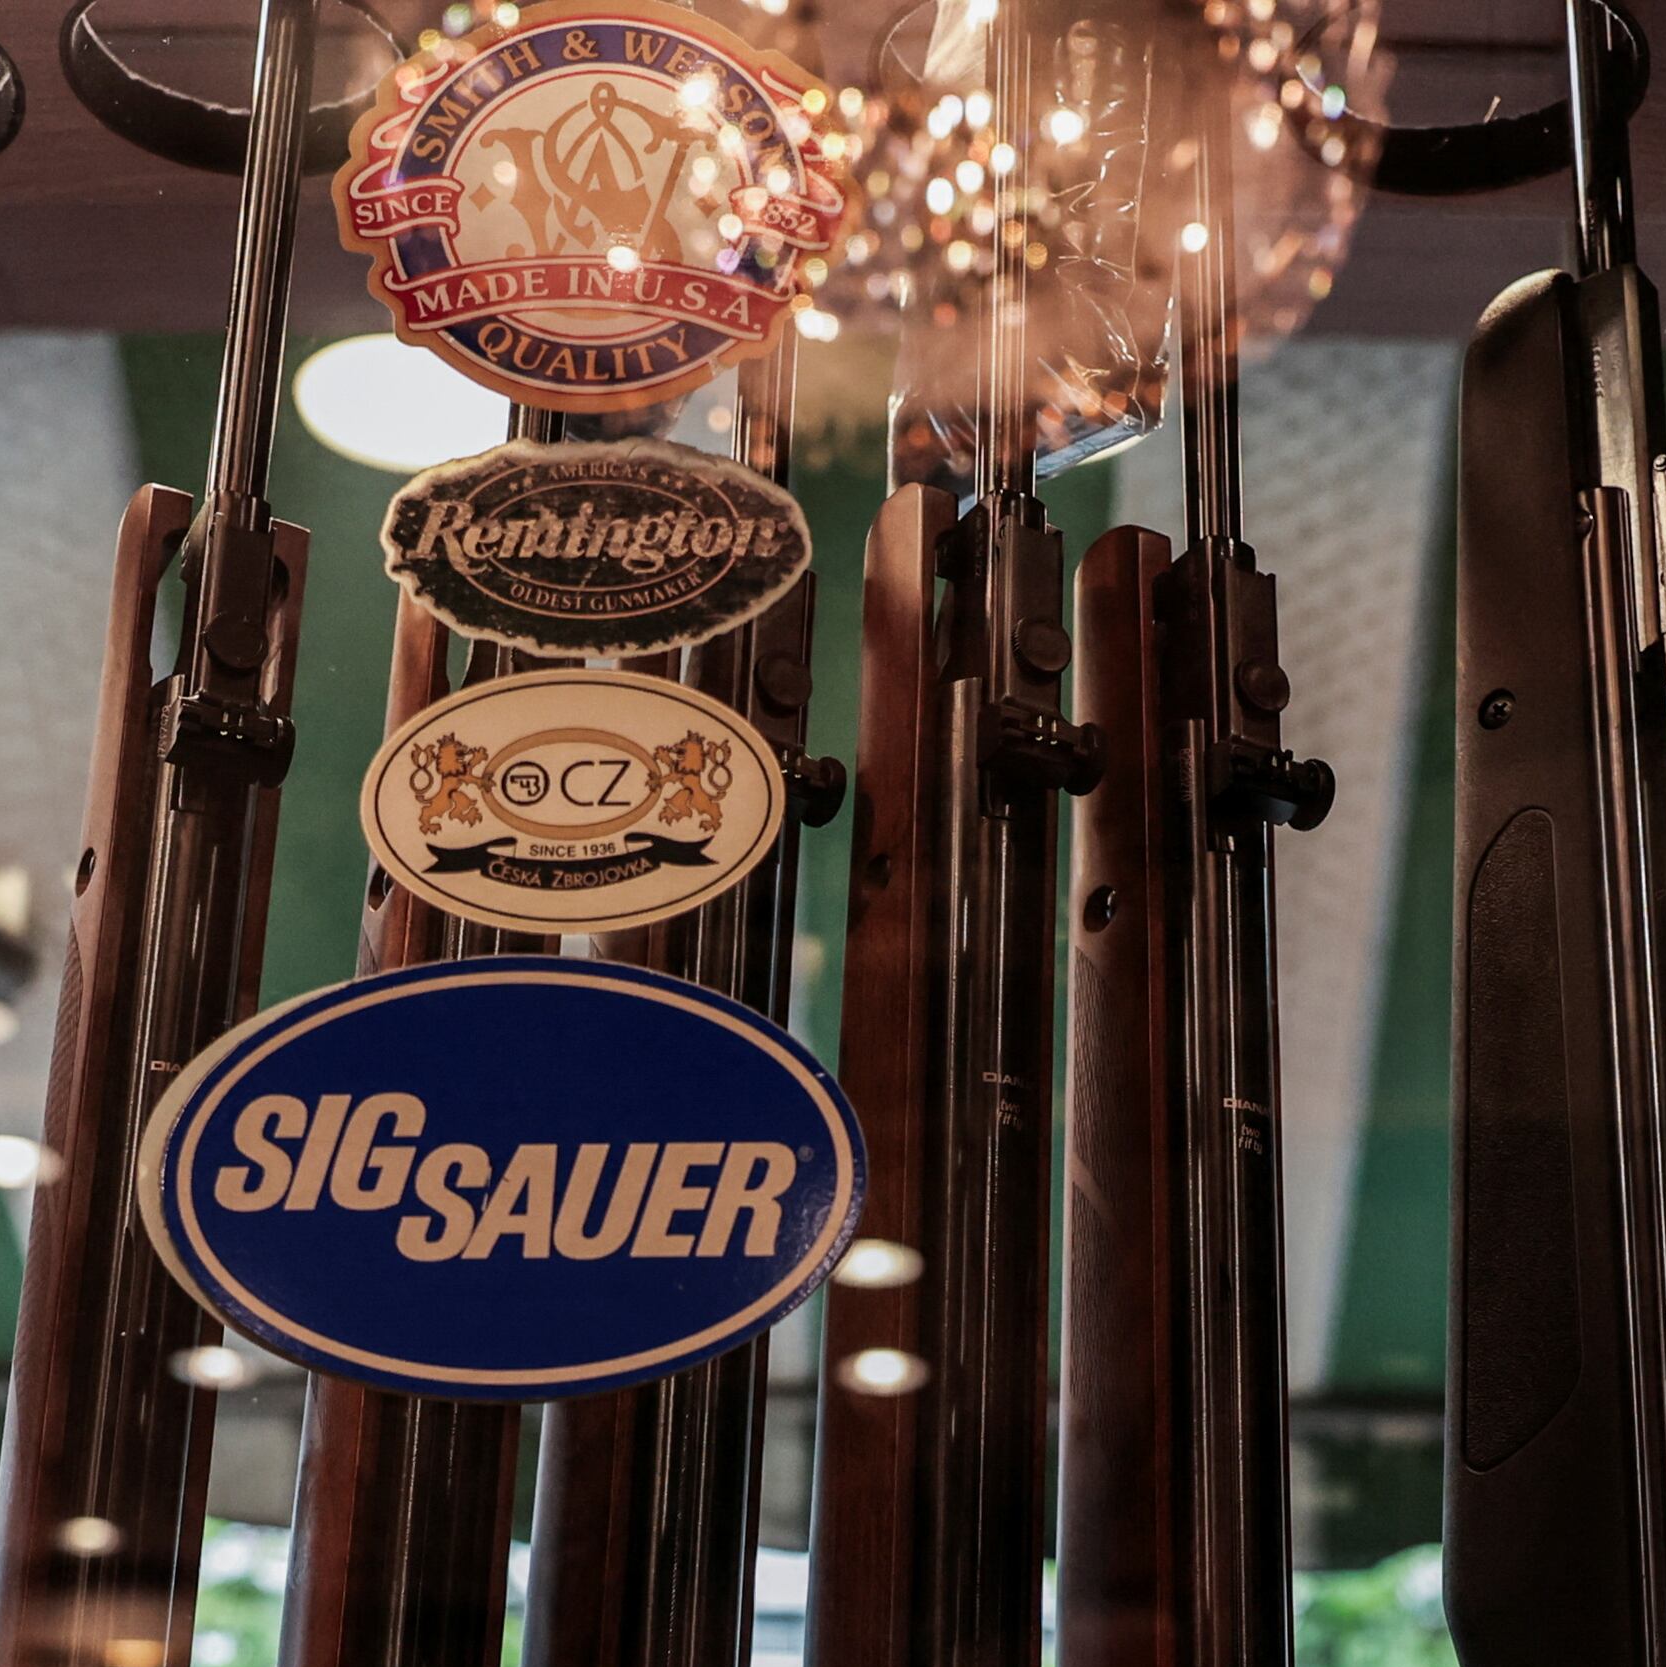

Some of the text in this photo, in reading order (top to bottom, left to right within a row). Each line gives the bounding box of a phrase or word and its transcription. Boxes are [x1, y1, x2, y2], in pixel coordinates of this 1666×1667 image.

[412, 38, 543, 164] SMITH
[562, 30, 599, 60] &
[356, 192, 453, 225] SINCE
[413, 266, 763, 331] MADE IN U.S.A.
[477, 321, 693, 382] QUALITY
[547, 463, 649, 482] AMERICA'S
[403, 500, 788, 574] Remington
[511, 572, 702, 611] OLDEST GUNMAKER
[561, 760, 632, 806] CZ
[489, 856, 653, 888] ČESKÁ ZBROJOVKA
[529, 842, 616, 858] SINCE 1936
[213, 1091, 797, 1262] SIG SAUER
